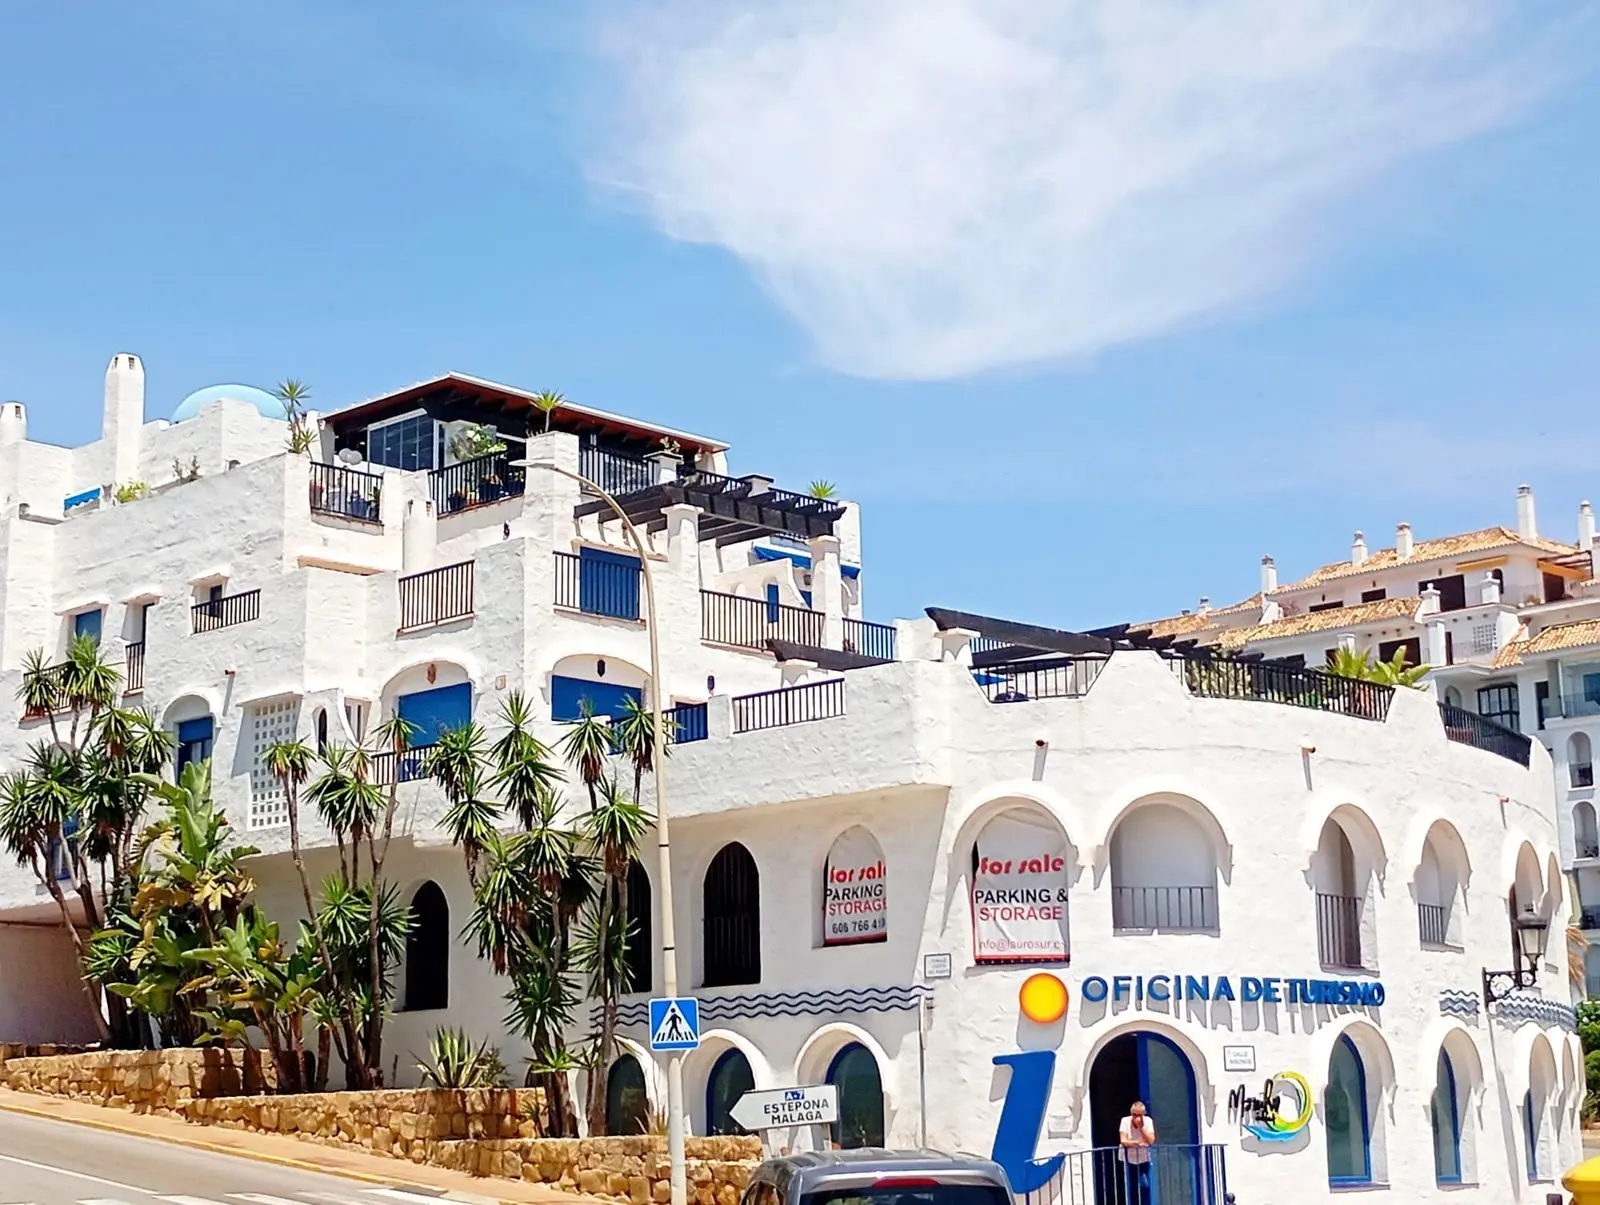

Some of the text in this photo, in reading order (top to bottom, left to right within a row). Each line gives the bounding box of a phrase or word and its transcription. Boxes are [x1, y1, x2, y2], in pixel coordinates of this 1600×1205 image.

[981, 853, 1064, 875] for sale
[826, 884, 883, 901] PARKING
[975, 888, 1068, 904] PARKING &
[979, 906, 1063, 921] STORAGE
[1081, 974, 1385, 1007] OFICINA DE TURISMO
[763, 1098, 830, 1114] ESTEPONA
[771, 1111, 823, 1125] MALAGA
